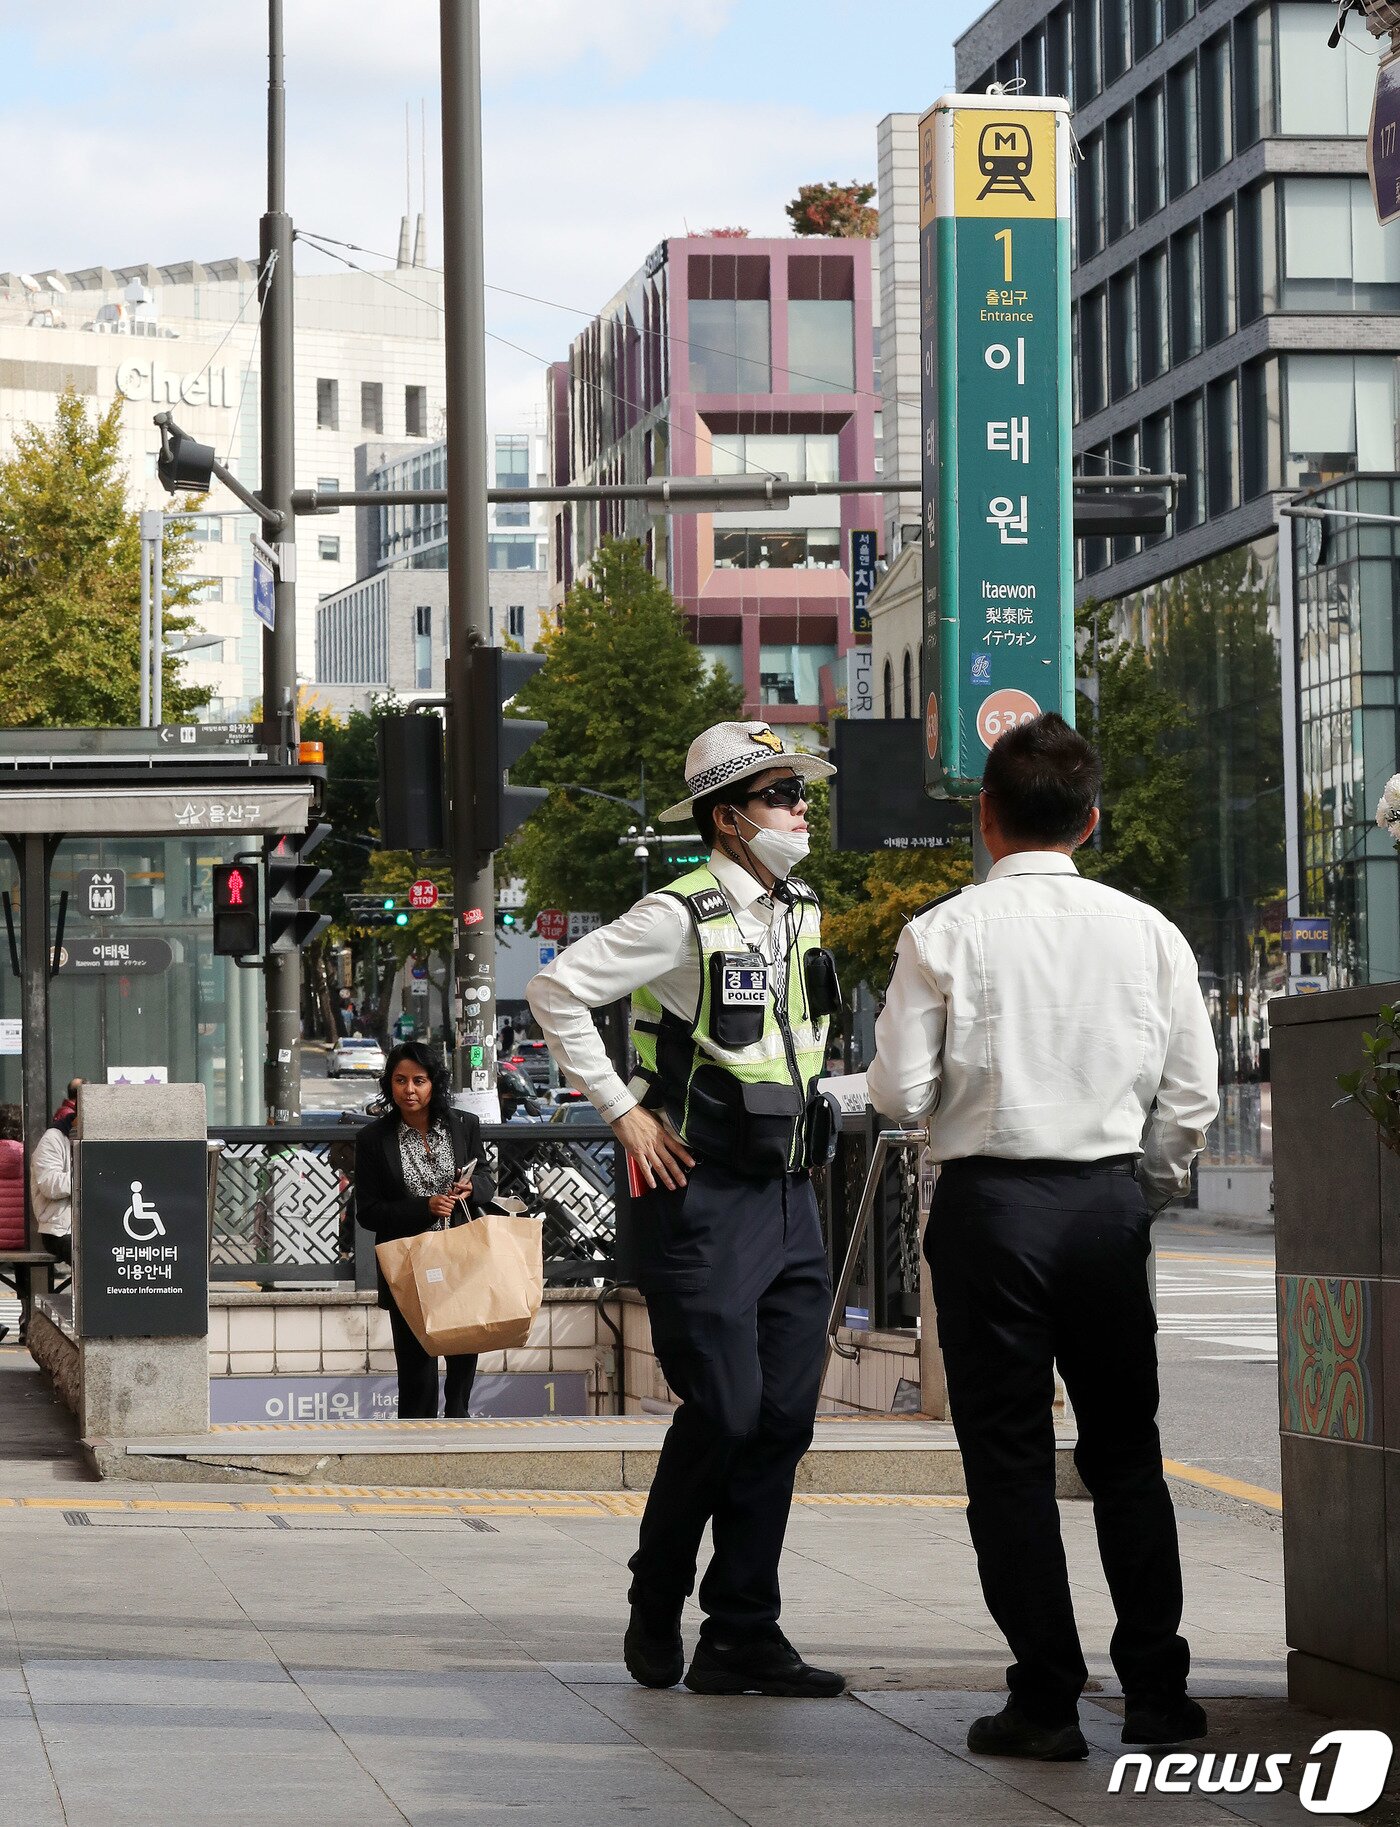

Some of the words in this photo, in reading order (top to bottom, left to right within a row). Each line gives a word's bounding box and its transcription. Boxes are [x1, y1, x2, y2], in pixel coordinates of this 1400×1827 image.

[1380, 121, 1396, 159] 177
[993, 228, 1013, 282] 1
[985, 290, 1028, 306] 출입구
[980, 310, 1034, 322] Entrance
[982, 580, 1036, 599] Itaewon
[986, 607, 1034, 625] 梨泰院
[982, 630, 1037, 646] イテウォン
[228, 723, 254, 733] 화장실
[209, 804, 261, 823] 용산구
[883, 837, 909, 849] 이태원
[412, 896, 434, 906] STOP
[540, 926, 562, 937] STOP
[1296, 930, 1328, 940] POLICE
[92, 944, 129, 959] 이태원
[727, 971, 764, 989] 경찰
[728, 992, 765, 1001] POLICE
[111, 1246, 178, 1262] 엘리베이터
[117, 1264, 172, 1280] 이용안내
[106, 1286, 138, 1294] Elevator
[138, 1286, 183, 1294] Information
[265, 1392, 359, 1420] 이태원
[544, 1383, 555, 1412] 1
